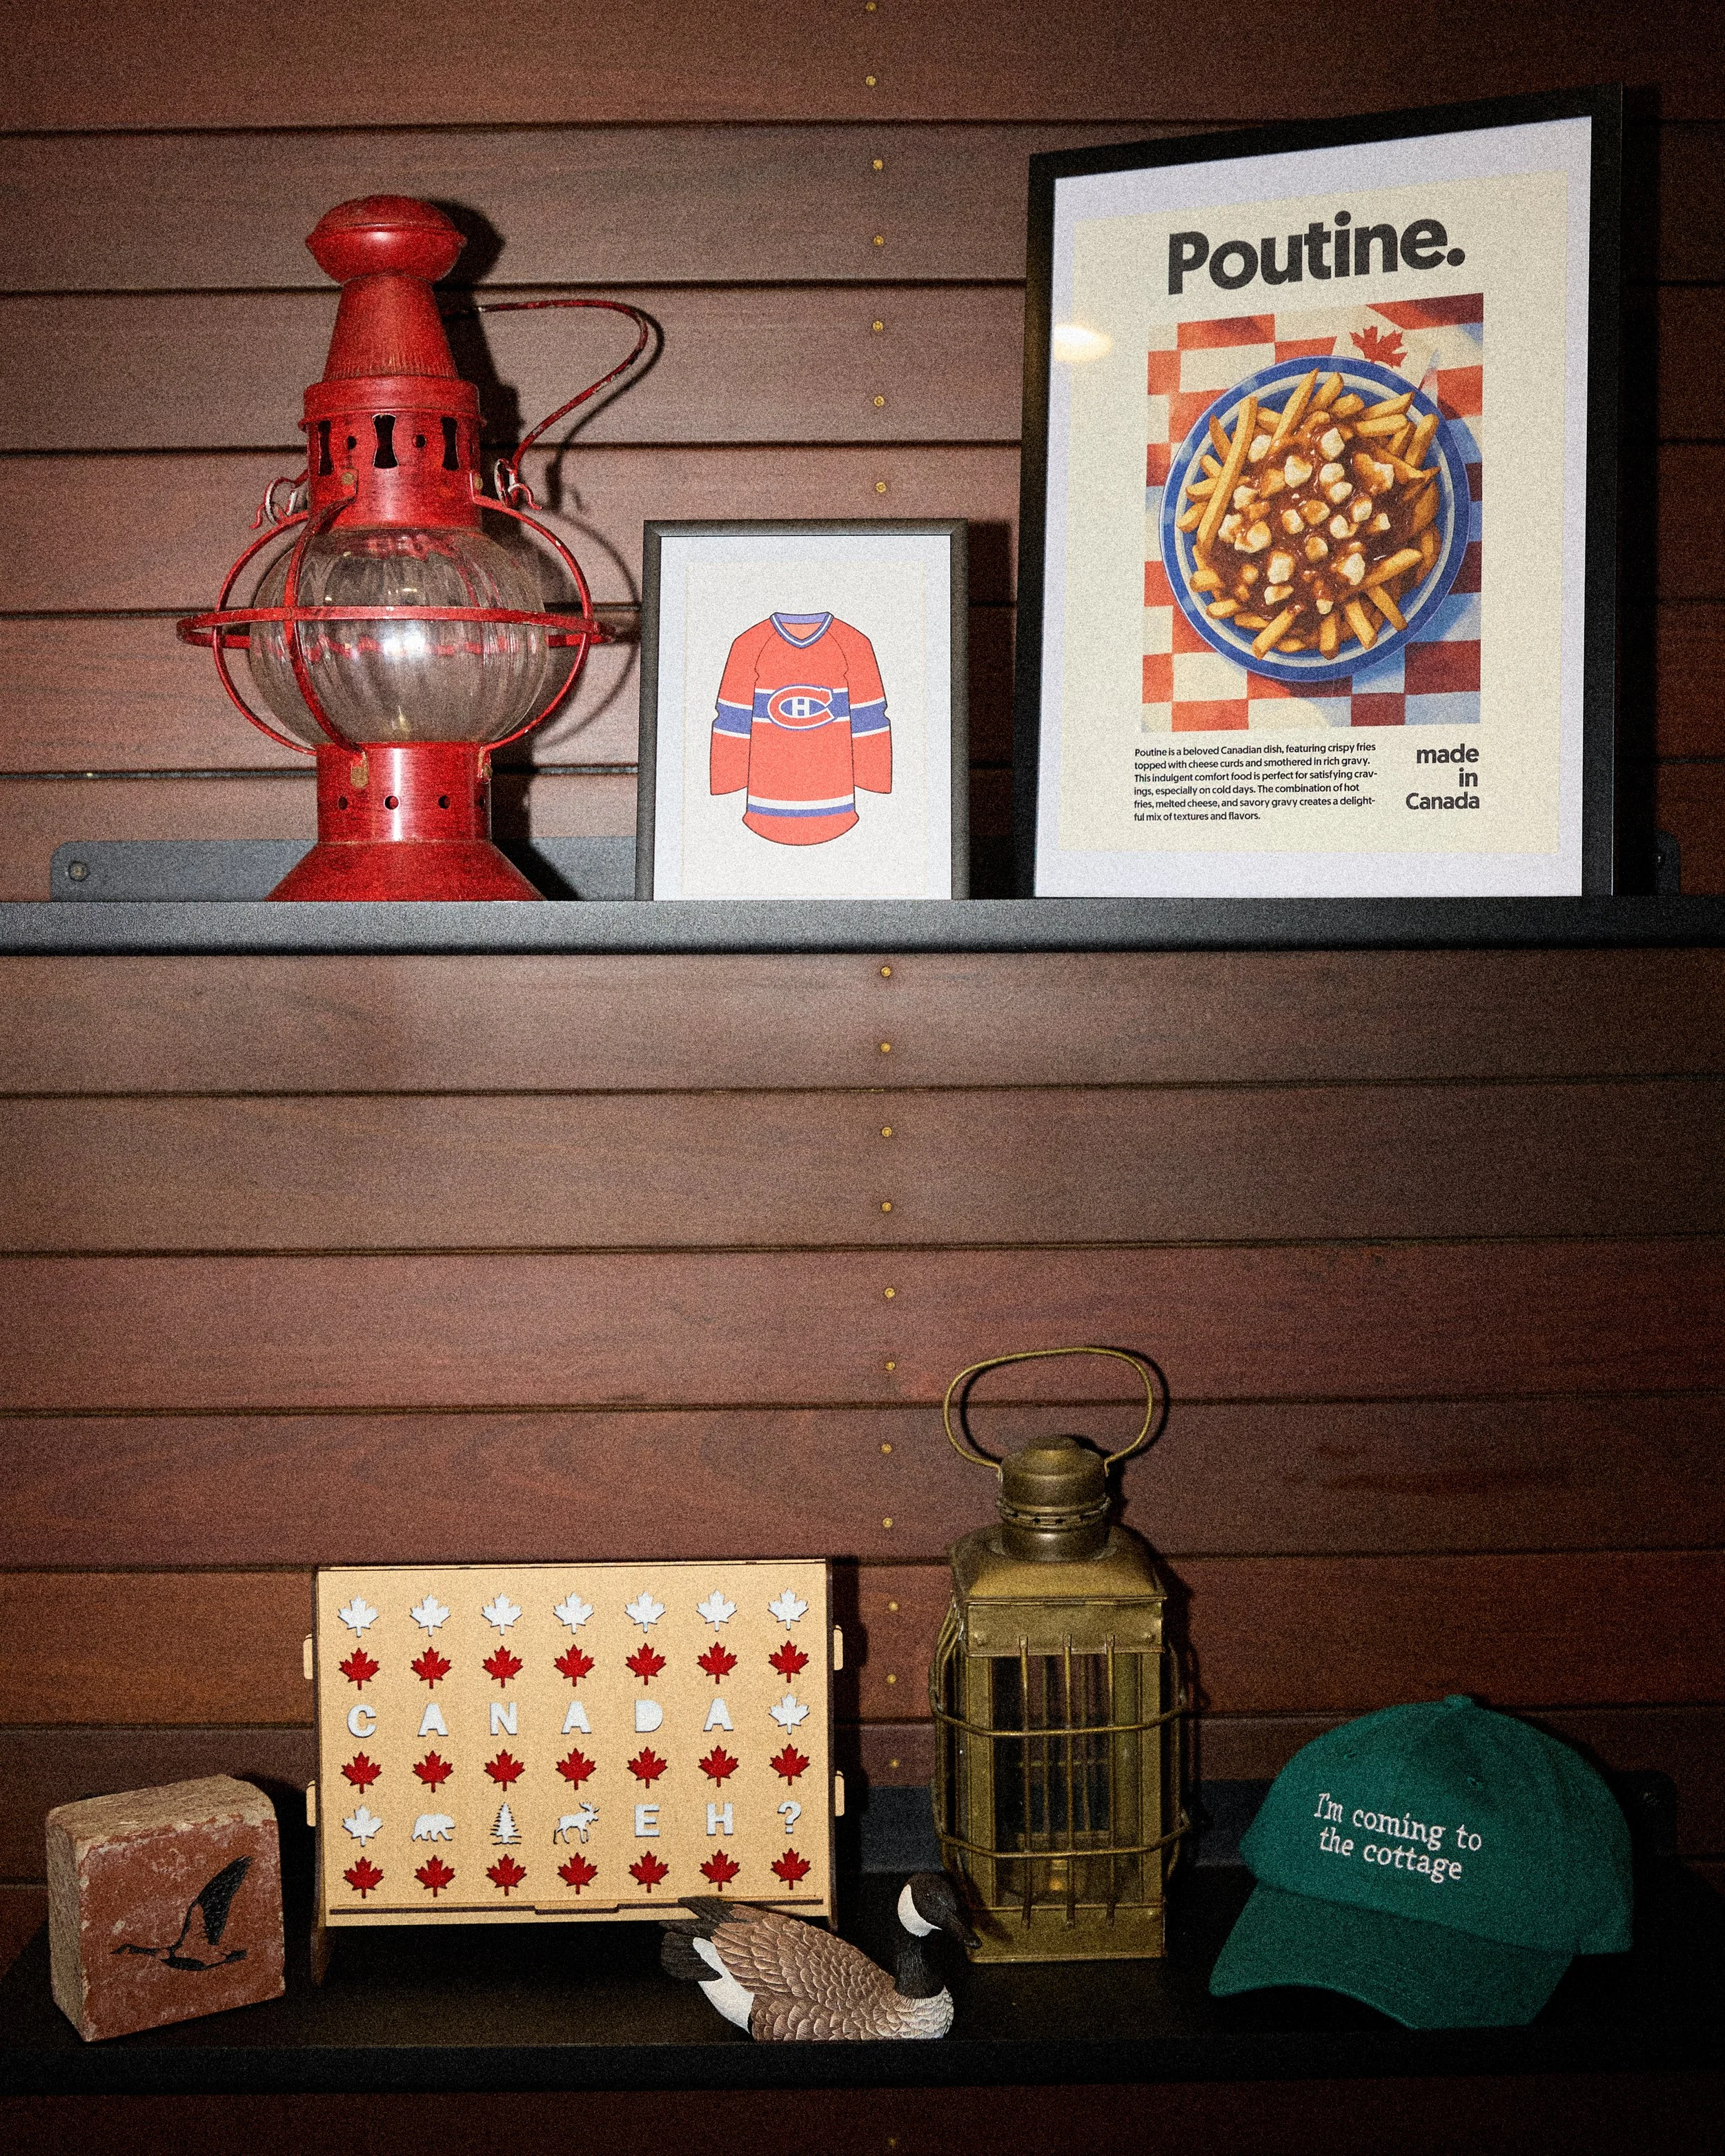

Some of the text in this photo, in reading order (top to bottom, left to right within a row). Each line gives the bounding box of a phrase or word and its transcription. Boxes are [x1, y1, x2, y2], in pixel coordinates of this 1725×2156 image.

[1168, 210, 1466, 295] Poutine.
[1135, 748, 1167, 756] Poutine
[1183, 746, 1219, 755] beloved
[1221, 746, 1261, 754] Canadian
[1264, 745, 1284, 753] dish,
[1286, 744, 1325, 753] featuring
[1328, 744, 1354, 753] crispy
[1417, 744, 1479, 763] made
[1135, 761, 1166, 771] topped
[1168, 760, 1187, 769] with
[1220, 759, 1243, 767] curds
[1264, 758, 1311, 767] smothered
[1323, 757, 1339, 765] rich
[1341, 758, 1370, 767] gravy.
[1152, 774, 1192, 783] indulgent
[1195, 773, 1229, 781] comfort
[1231, 772, 1252, 780] food
[1262, 771, 1293, 781] perfect
[1310, 770, 1352, 780] satisfying
[1459, 767, 1478, 787] in
[1134, 787, 1154, 796] ings,
[1156, 787, 1197, 795] especially
[1232, 786, 1256, 795] days.
[1275, 784, 1331, 793] combination
[1333, 783, 1342, 792] of
[1134, 800, 1154, 809] fries,
[1187, 799, 1220, 808] cheese,
[1272, 799, 1297, 807] gravy
[1299, 798, 1331, 806] creates
[1340, 796, 1375, 806] delight-
[1406, 791, 1479, 810] Canada
[1134, 813, 1144, 821] ful
[346, 1698, 734, 1737] CANADA
[634, 1801, 802, 1837] EH?
[1314, 1793, 1481, 1851] I'm coming to
[1319, 1827, 1462, 1883] the cottage
